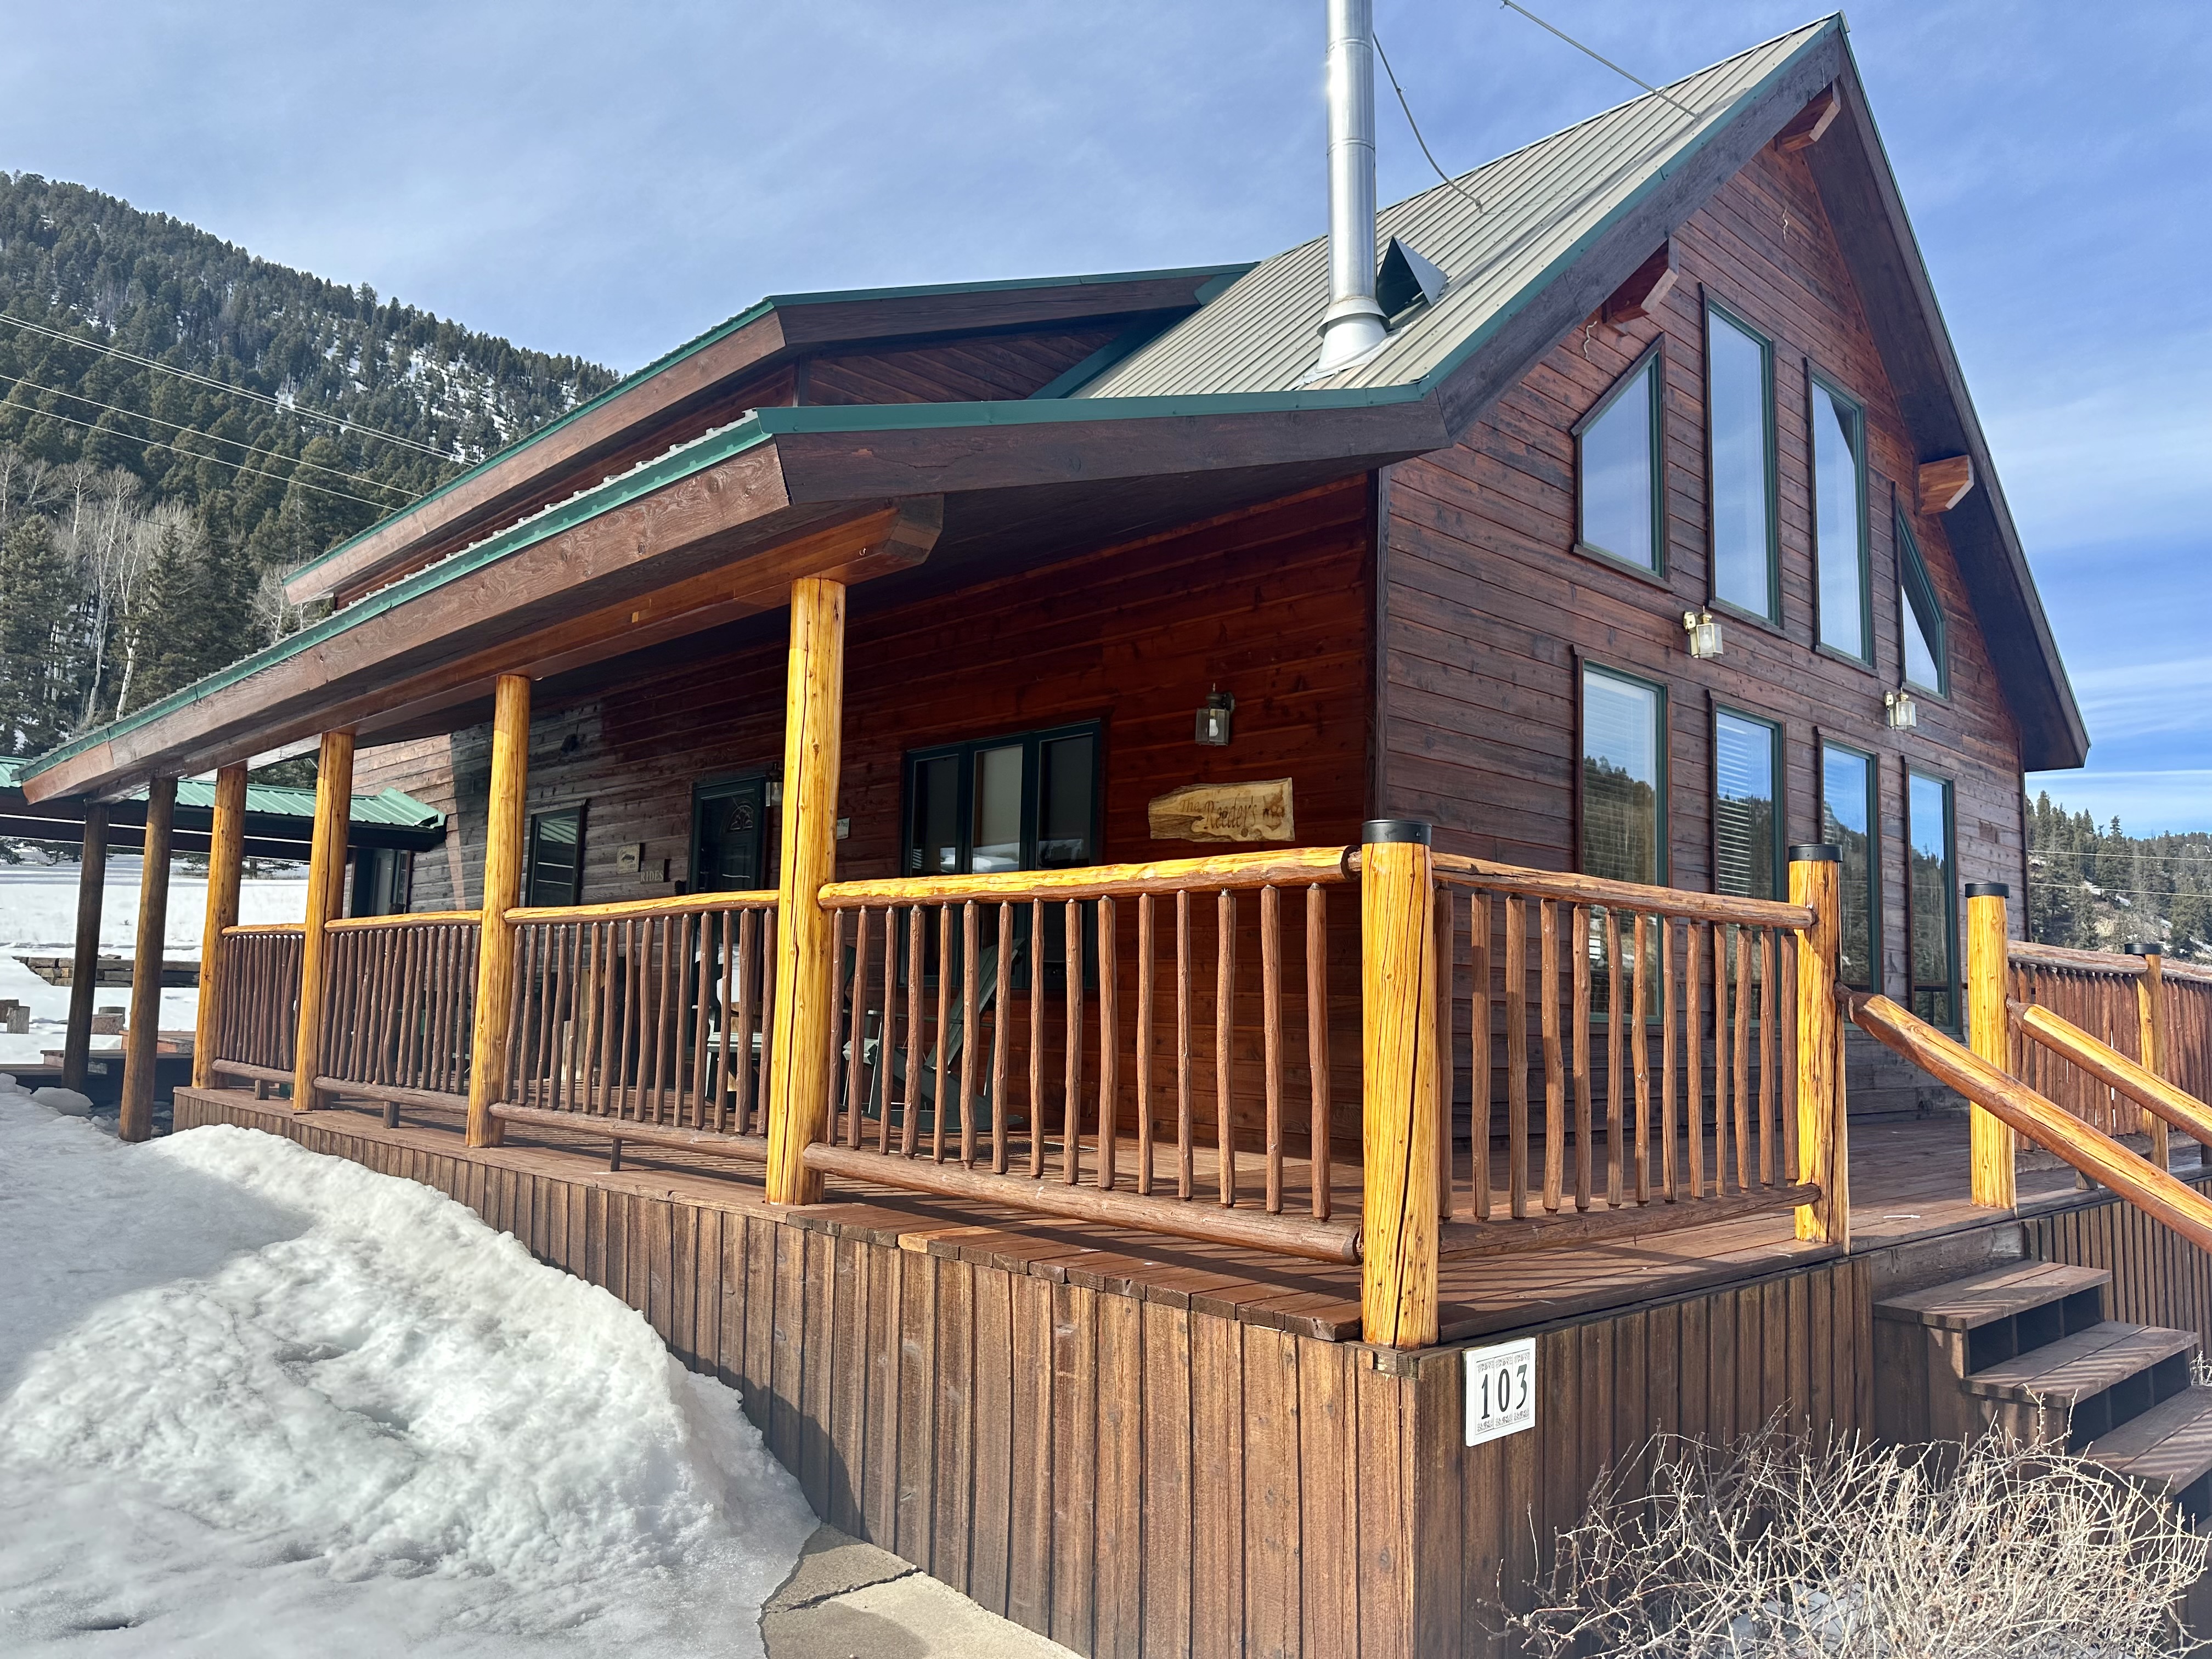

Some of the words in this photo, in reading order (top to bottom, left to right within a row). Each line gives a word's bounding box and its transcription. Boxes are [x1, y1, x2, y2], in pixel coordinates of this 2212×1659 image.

[1180, 798, 1200, 812] The
[1204, 793, 1257, 829] Reeder's
[641, 870, 664, 882] RIDES
[1482, 1364, 1527, 1420] 103
